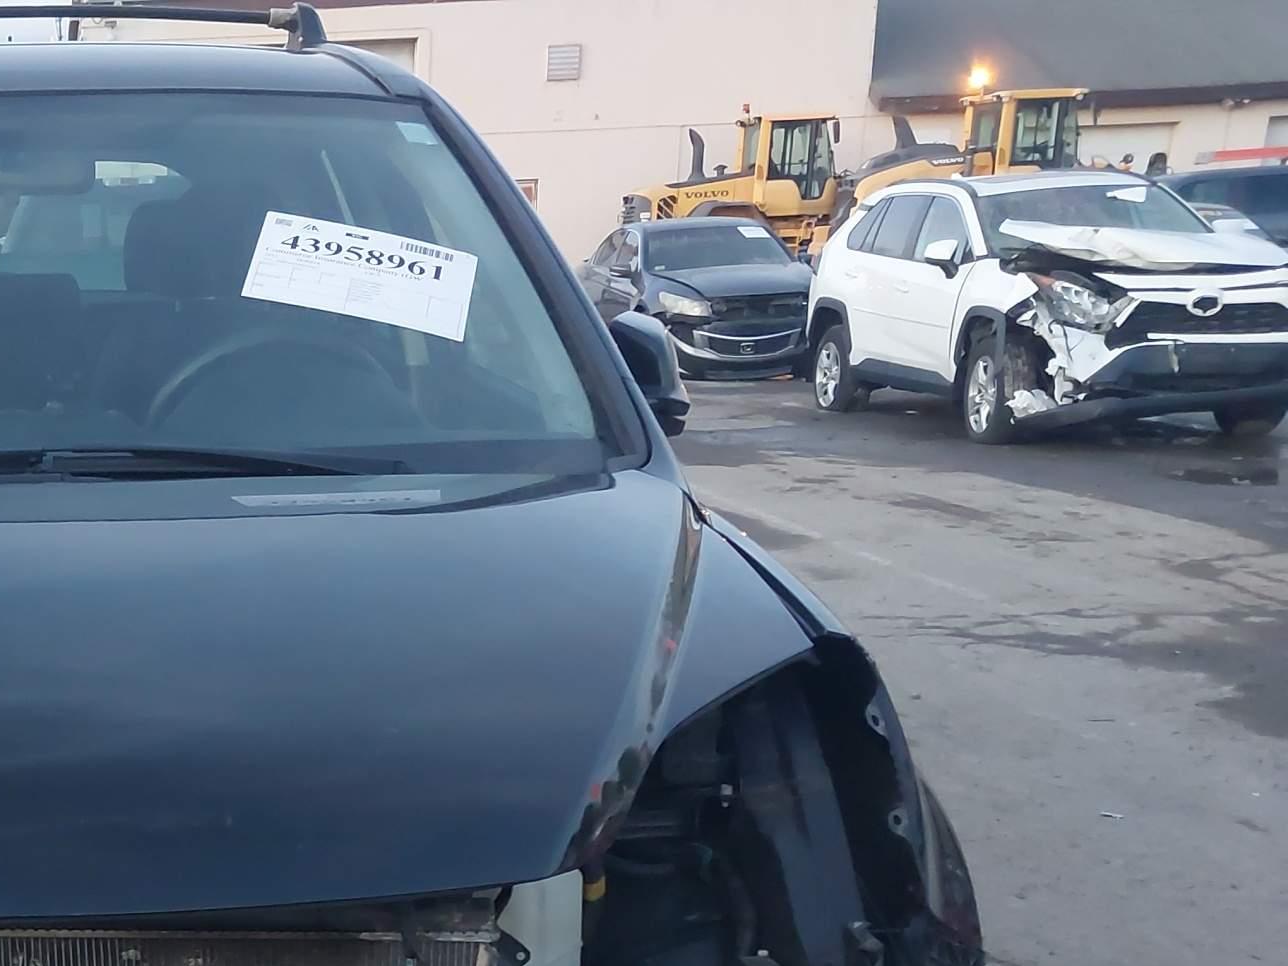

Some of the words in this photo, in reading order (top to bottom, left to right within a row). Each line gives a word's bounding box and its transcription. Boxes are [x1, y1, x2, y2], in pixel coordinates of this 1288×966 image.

[931, 157, 965, 165] VOLVO
[685, 190, 729, 199] VOLVO
[280, 235, 444, 281] 43958961
